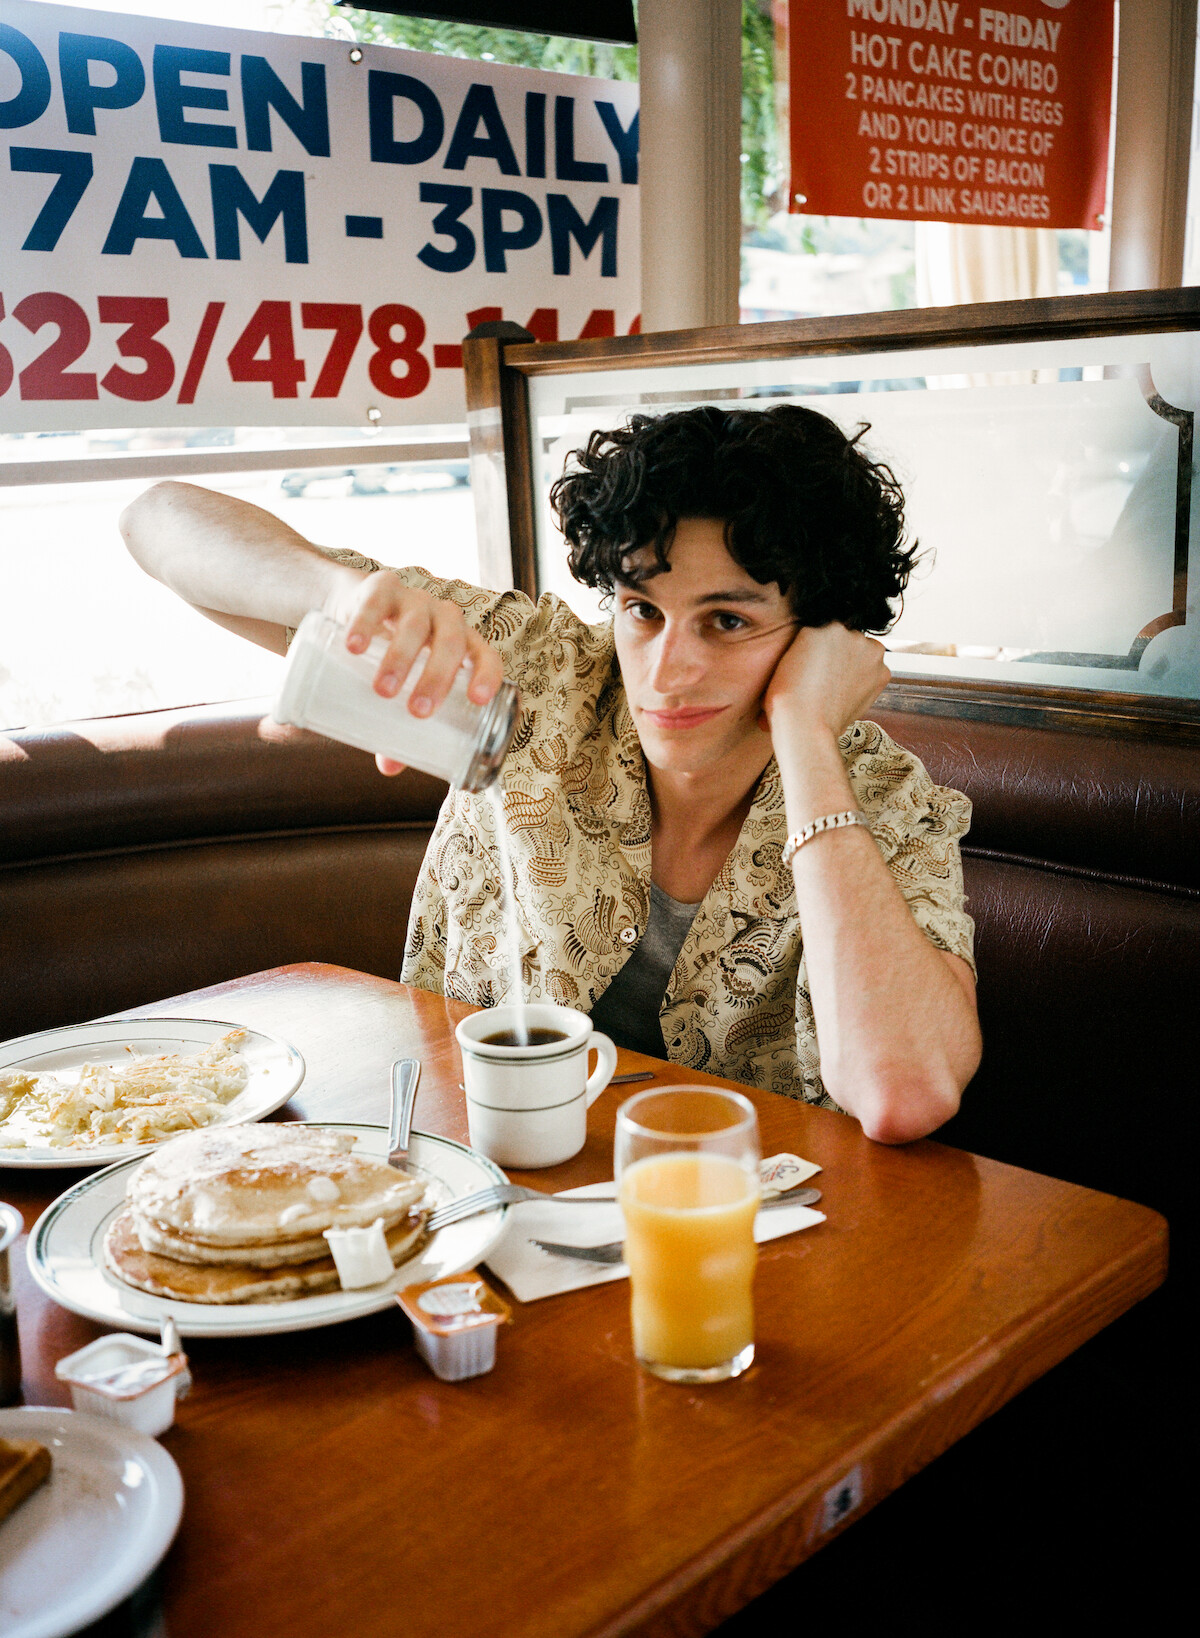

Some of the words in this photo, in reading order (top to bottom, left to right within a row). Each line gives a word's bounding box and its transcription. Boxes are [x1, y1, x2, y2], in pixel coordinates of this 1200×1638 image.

[847, 0, 959, 35] MONDAY
[964, 18, 974, 29] -
[980, 8, 1061, 53] FRIDAY
[851, 30, 902, 70] HOT
[908, 41, 973, 81] CAKE
[978, 53, 1058, 94] COMBO
[844, 73, 857, 99] 2
[863, 75, 965, 115] PANCAKES
[968, 90, 1015, 120] WITH
[1021, 97, 1064, 126] EGGS
[368, 70, 640, 185] DAILY
[857, 111, 900, 141] AND
[904, 116, 956, 148] YOUR
[961, 123, 1027, 153] CHOICE
[1030, 131, 1054, 156] OF
[869, 147, 882, 174] 2
[886, 149, 949, 180] STRIPS
[953, 156, 980, 182] OF
[985, 158, 1044, 188] BACON
[9, 146, 309, 264] 7AM
[345, 215, 383, 239] -
[417, 182, 619, 277] 3PM
[863, 181, 892, 209] OR
[897, 184, 908, 210] 2
[913, 186, 956, 214] LINK
[961, 190, 1050, 220] SAUSAGES
[0, 291, 641, 405] 23/478-
